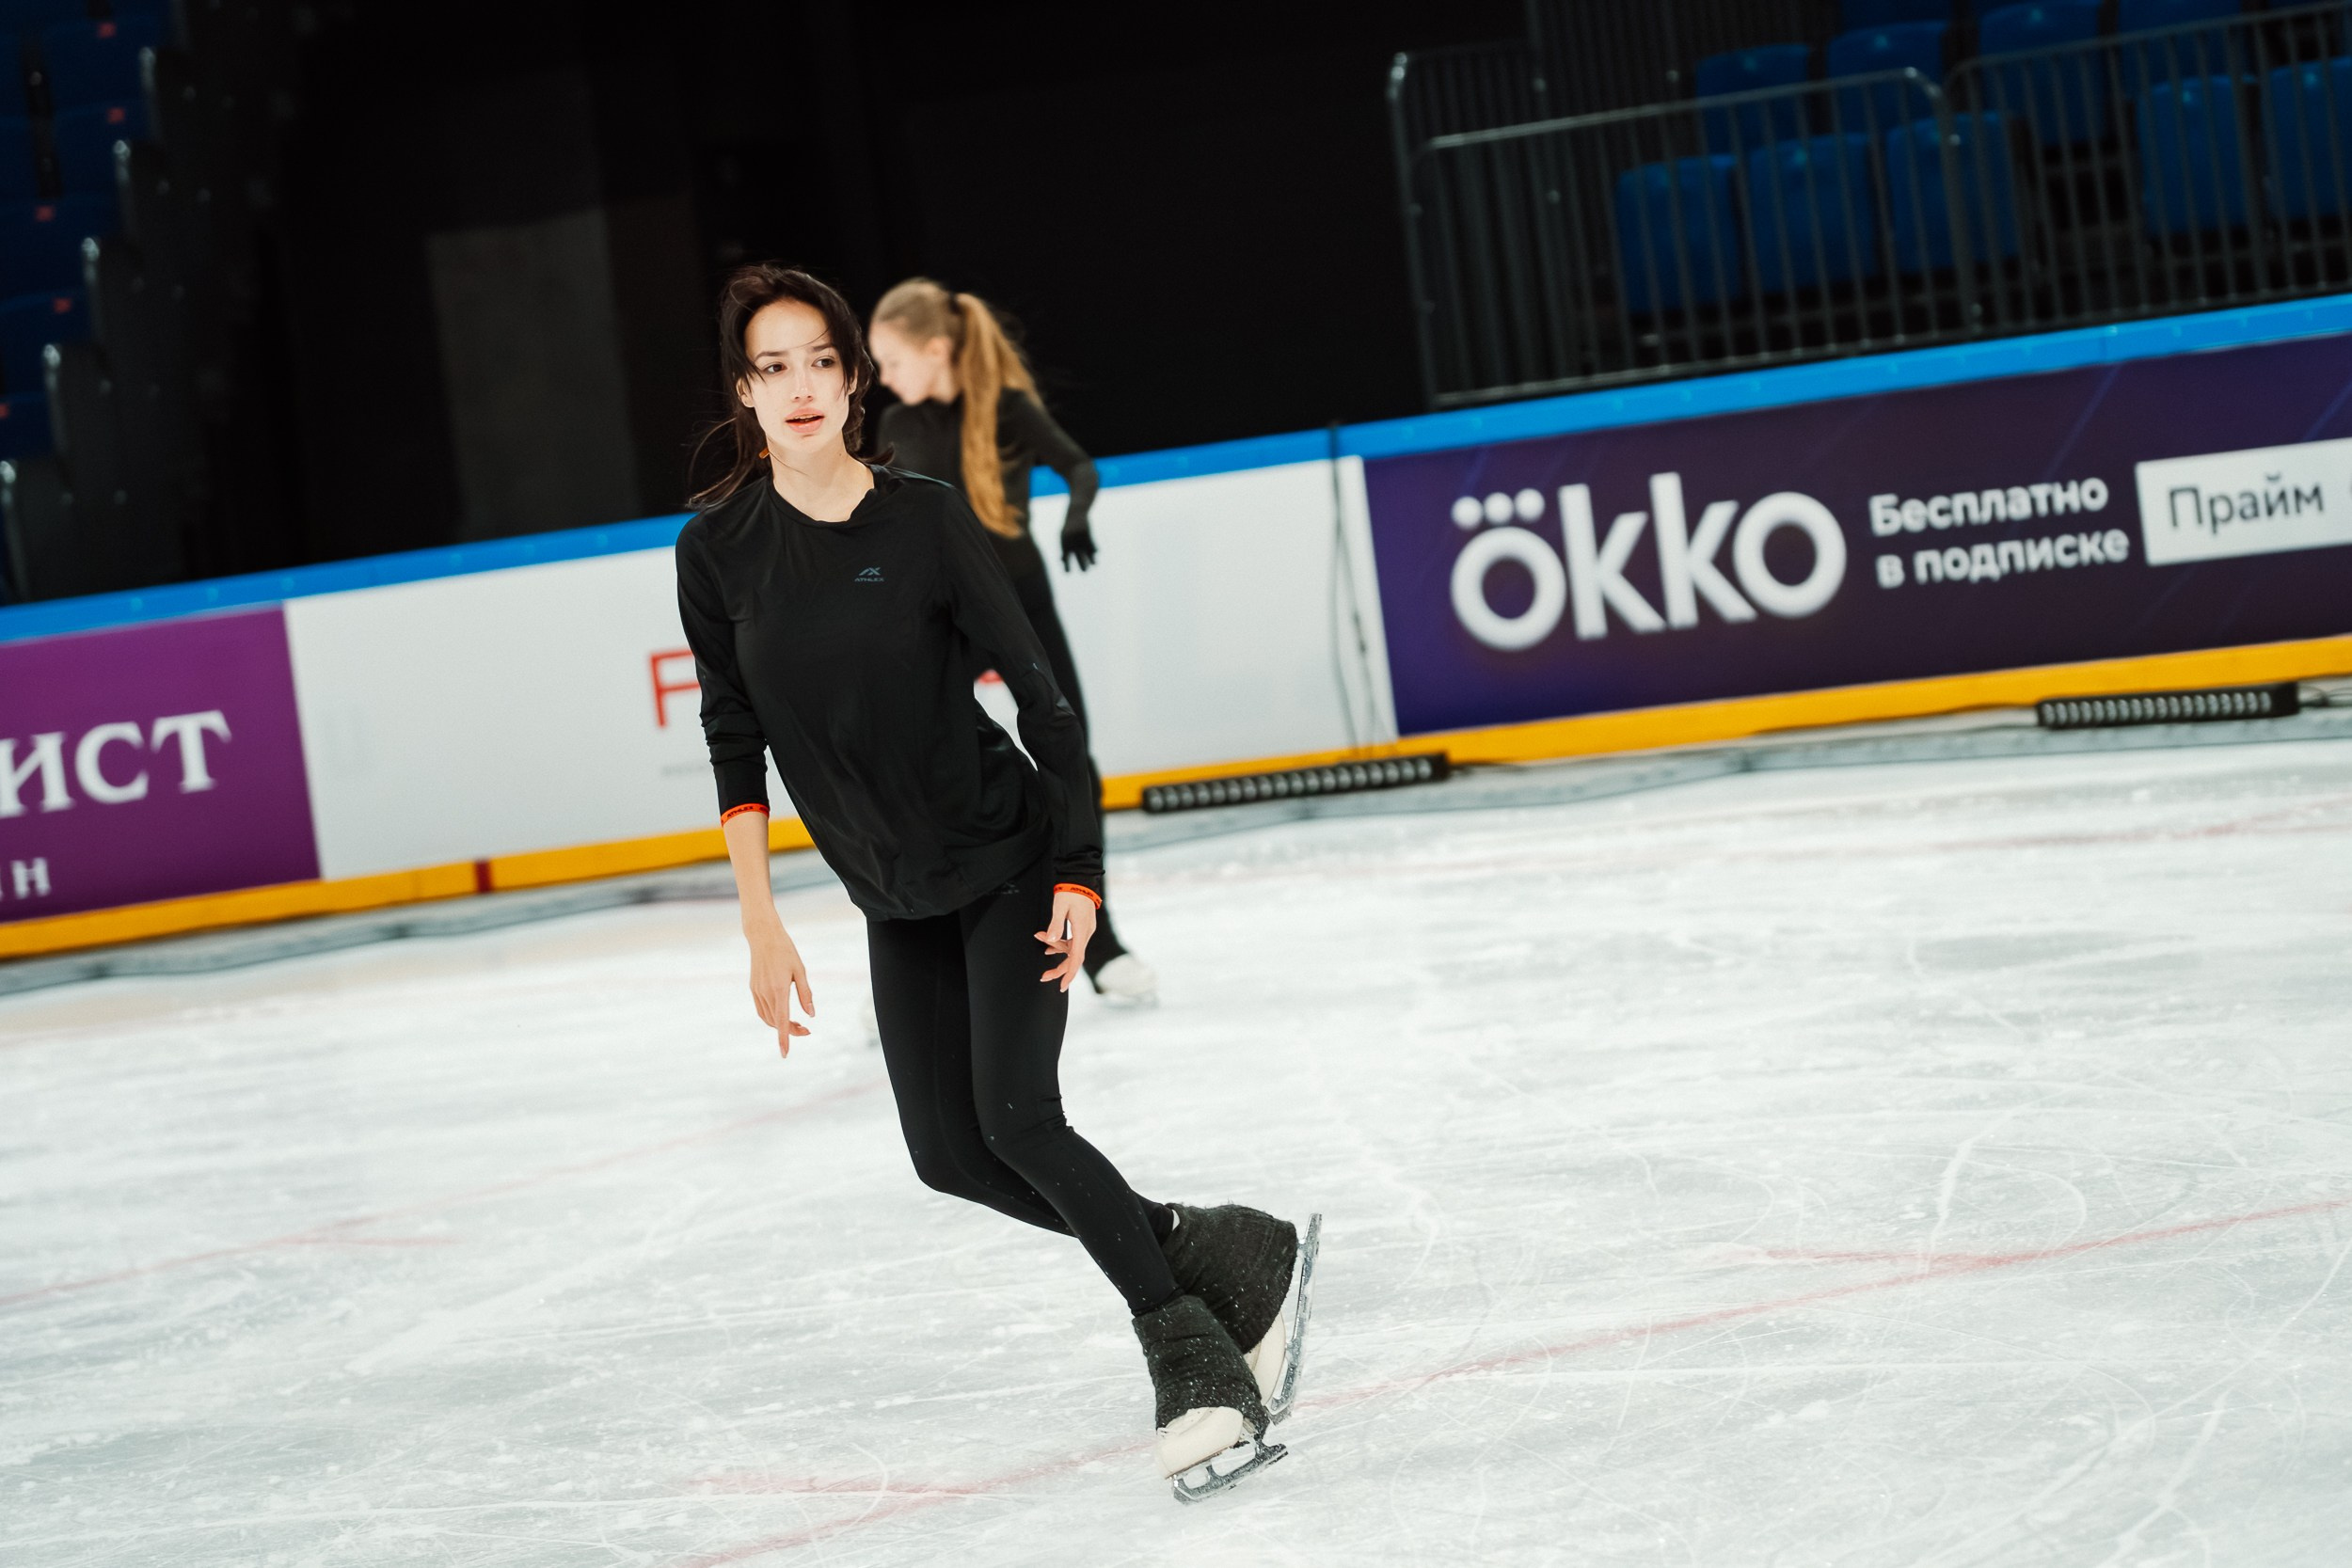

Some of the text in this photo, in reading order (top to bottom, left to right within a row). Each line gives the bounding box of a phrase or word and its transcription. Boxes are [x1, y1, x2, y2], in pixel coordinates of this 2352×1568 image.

[1868, 477, 2109, 537] Бесплатно
[2169, 473, 2324, 534] Прайм
[1875, 528, 2130, 590] в подписке
